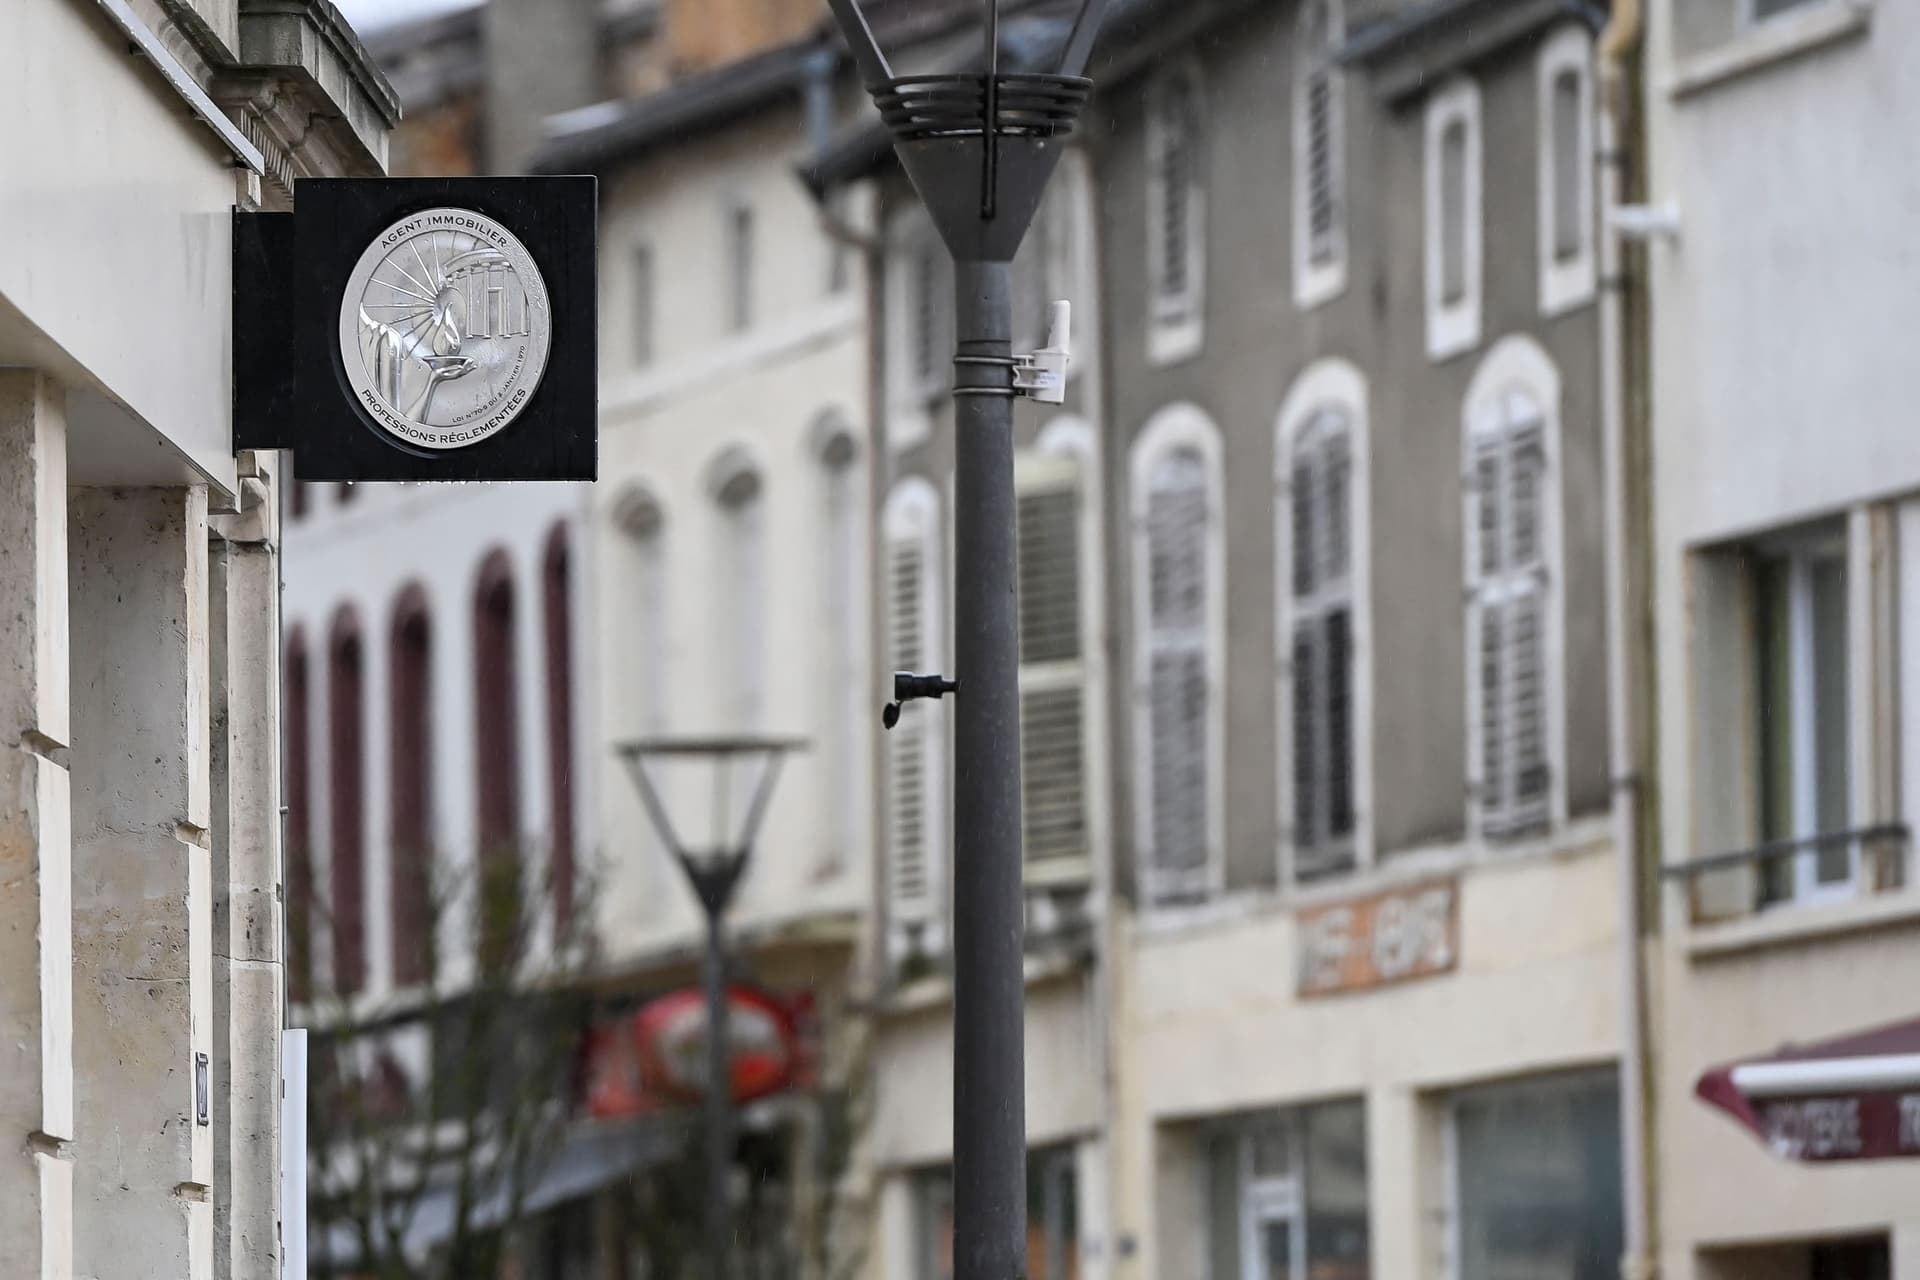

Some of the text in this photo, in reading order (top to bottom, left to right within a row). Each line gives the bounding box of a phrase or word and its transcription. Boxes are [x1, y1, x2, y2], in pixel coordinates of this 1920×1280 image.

[381, 215, 508, 249] AGENT IMMOBILIER
[361, 388, 527, 444] PROFESSIONS RÉGLEMENTÉES
